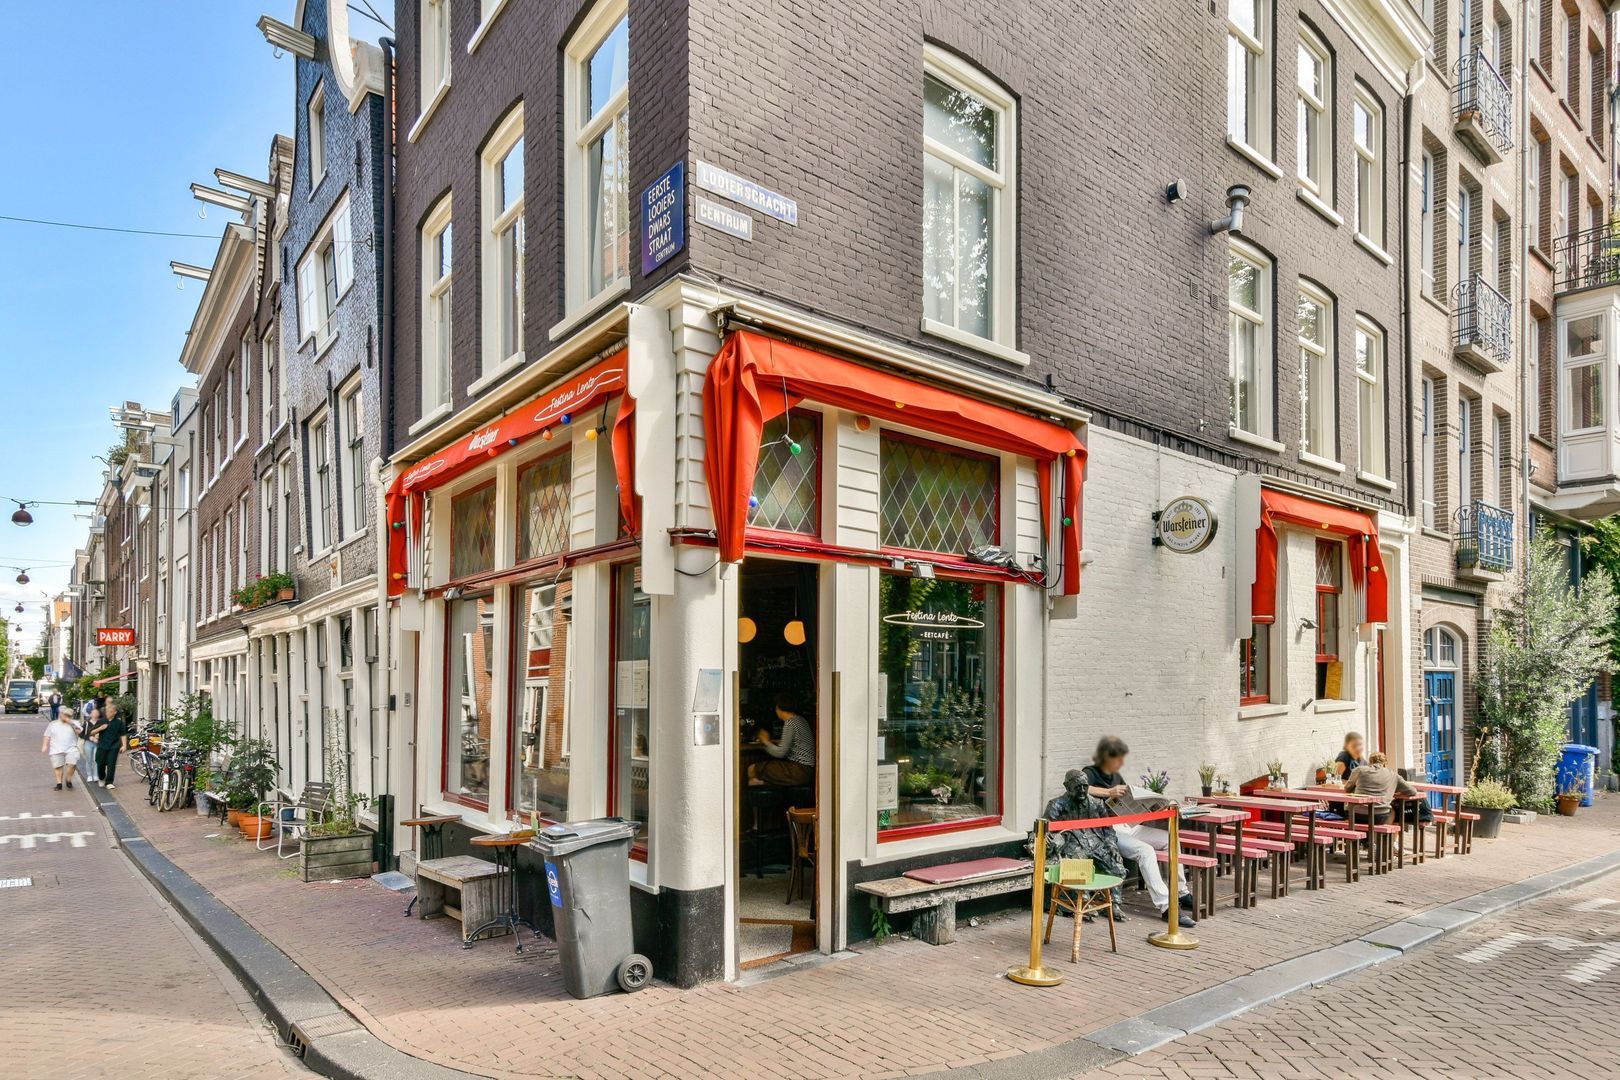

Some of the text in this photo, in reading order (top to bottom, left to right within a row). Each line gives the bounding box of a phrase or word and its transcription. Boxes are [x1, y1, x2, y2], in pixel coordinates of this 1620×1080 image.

[648, 175, 671, 205] EERSTE
[702, 167, 793, 218] LOOIERSGRACHT
[648, 189, 675, 222] LOOIERS
[700, 204, 748, 234] CENTRUM
[648, 210, 671, 239] DWARS
[648, 227, 672, 256] STRAAT
[655, 241, 676, 263] CENTRUM
[549, 390, 575, 412] Festina
[1162, 517, 1206, 533] Warsteiner
[906, 609, 958, 623] Festina Lente
[99, 631, 132, 642] PARRY
